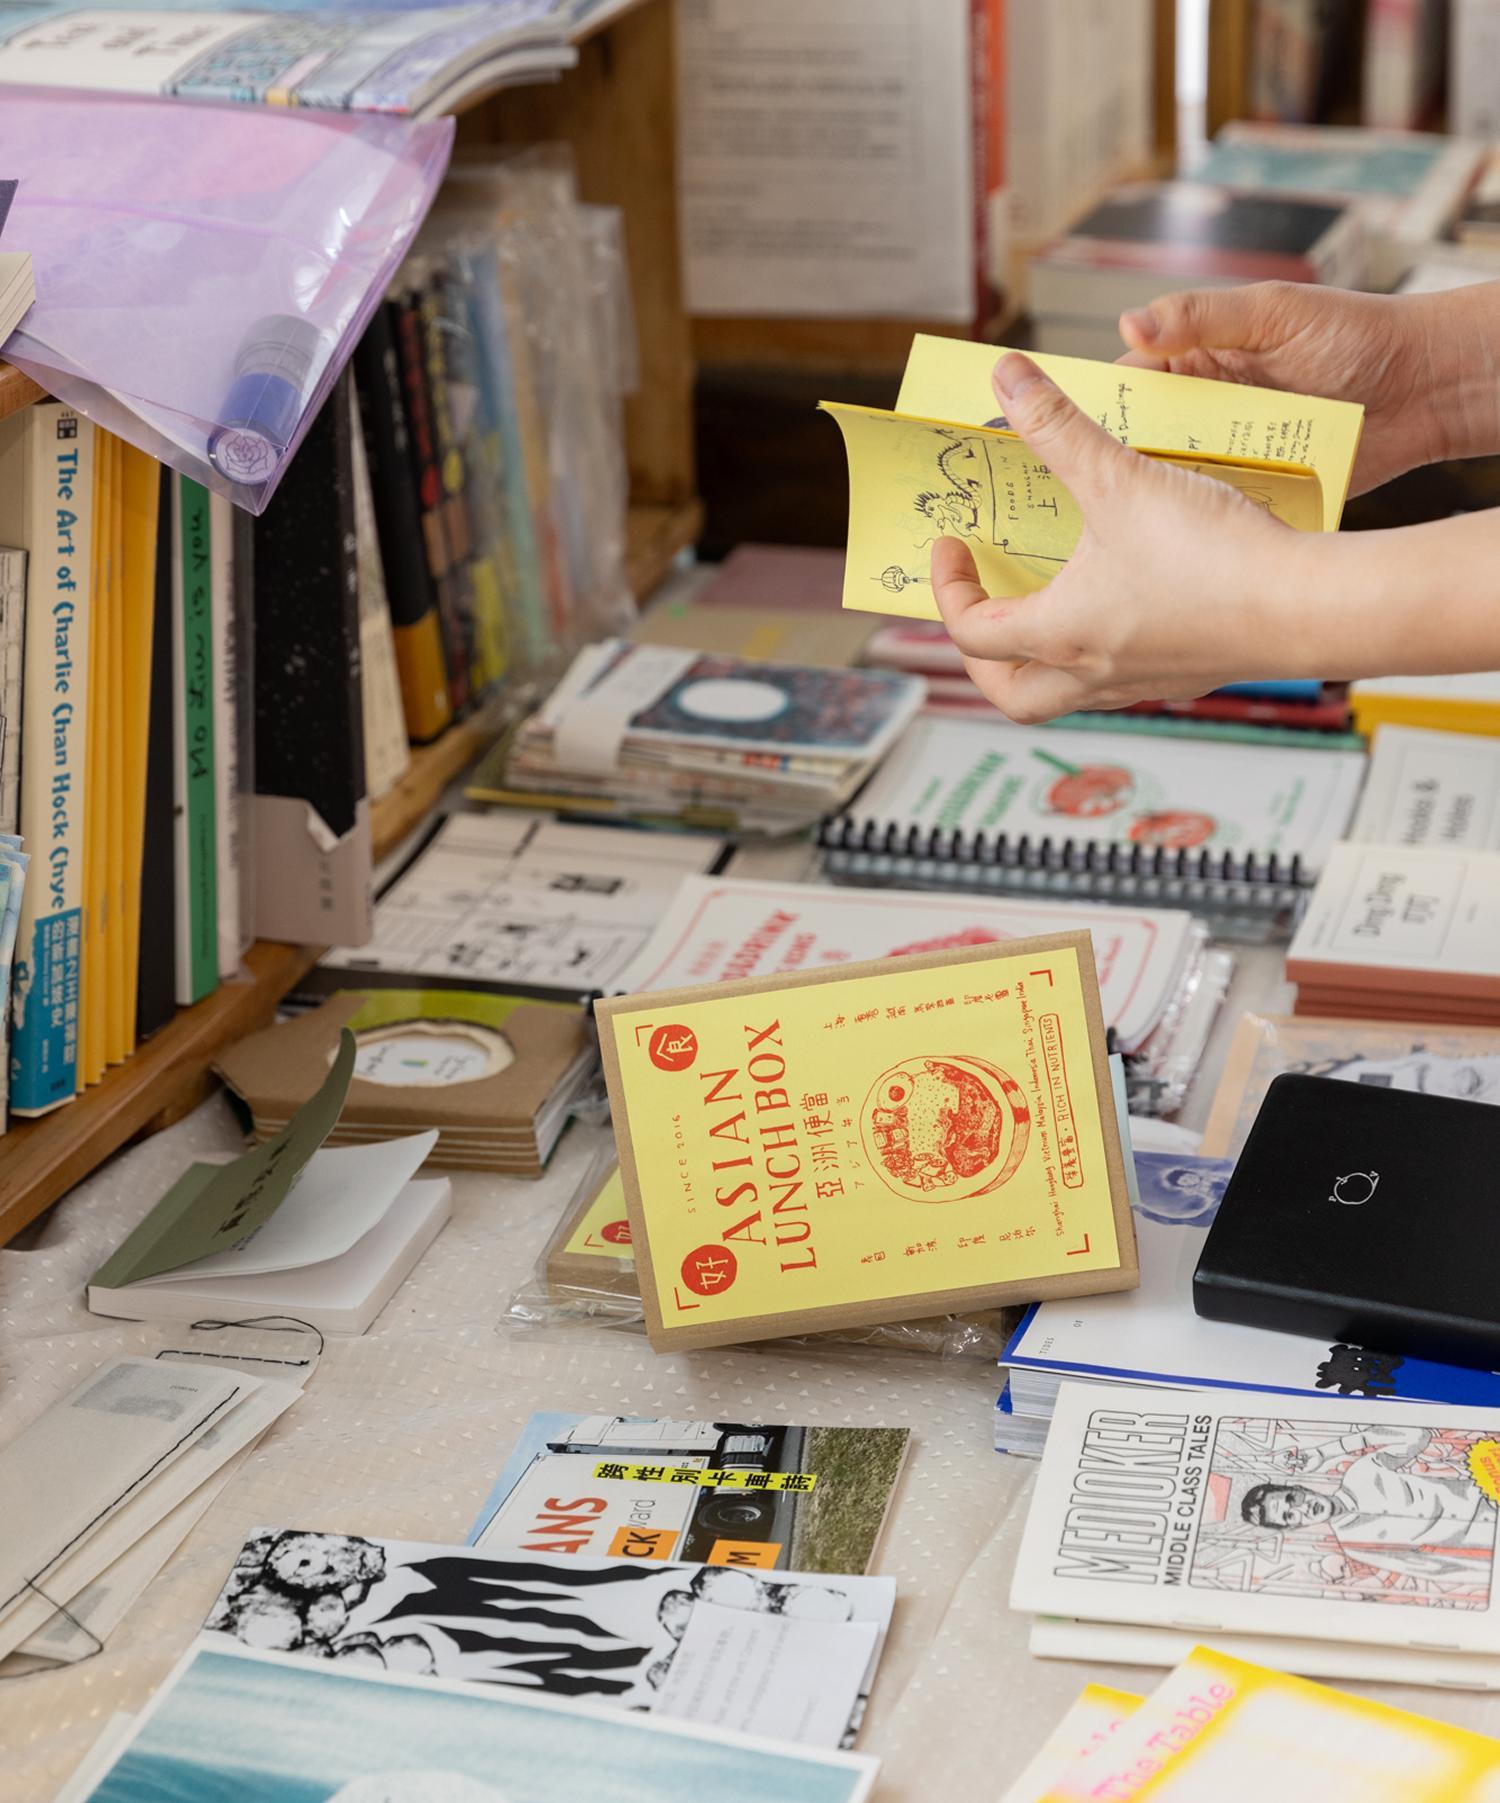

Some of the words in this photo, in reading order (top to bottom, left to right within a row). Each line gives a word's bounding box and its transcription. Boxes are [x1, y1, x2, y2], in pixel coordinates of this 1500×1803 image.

[57, 448, 78, 500] The
[1006, 482, 1019, 520] FOODS
[56, 509, 78, 557] Art
[190, 508, 209, 572] you
[56, 566, 76, 592] of
[53, 601, 75, 694] Charlie
[52, 702, 73, 766] Chan
[51, 773, 71, 840] Hock
[49, 846, 70, 909] Chye
[656, 1033, 694, 1063] 食
[1043, 1016, 1062, 1073] NUTRIENTS
[1053, 1076, 1063, 1091] IN
[1057, 1095, 1070, 1122] RICH
[672, 1114, 686, 1150] 2016
[700, 1068, 767, 1246] ASIAN
[743, 1018, 817, 1273] LUNCHBOX
[799, 1092, 845, 1199] 亞洲便當
[678, 1158, 697, 1214] SINCE
[1052, 1199, 1065, 1237] Shanghai
[695, 1256, 729, 1290] 好
[1187, 1414, 1213, 1463] TALES
[596, 1463, 814, 1491] 跨性別卡車詩
[1053, 1409, 1190, 1586] MEDIOKER
[1176, 1466, 1203, 1518] CLASS
[1163, 1521, 1192, 1587] MIDDLE
[1091, 1758, 1164, 1801] The
[1145, 1683, 1236, 1754] Table
